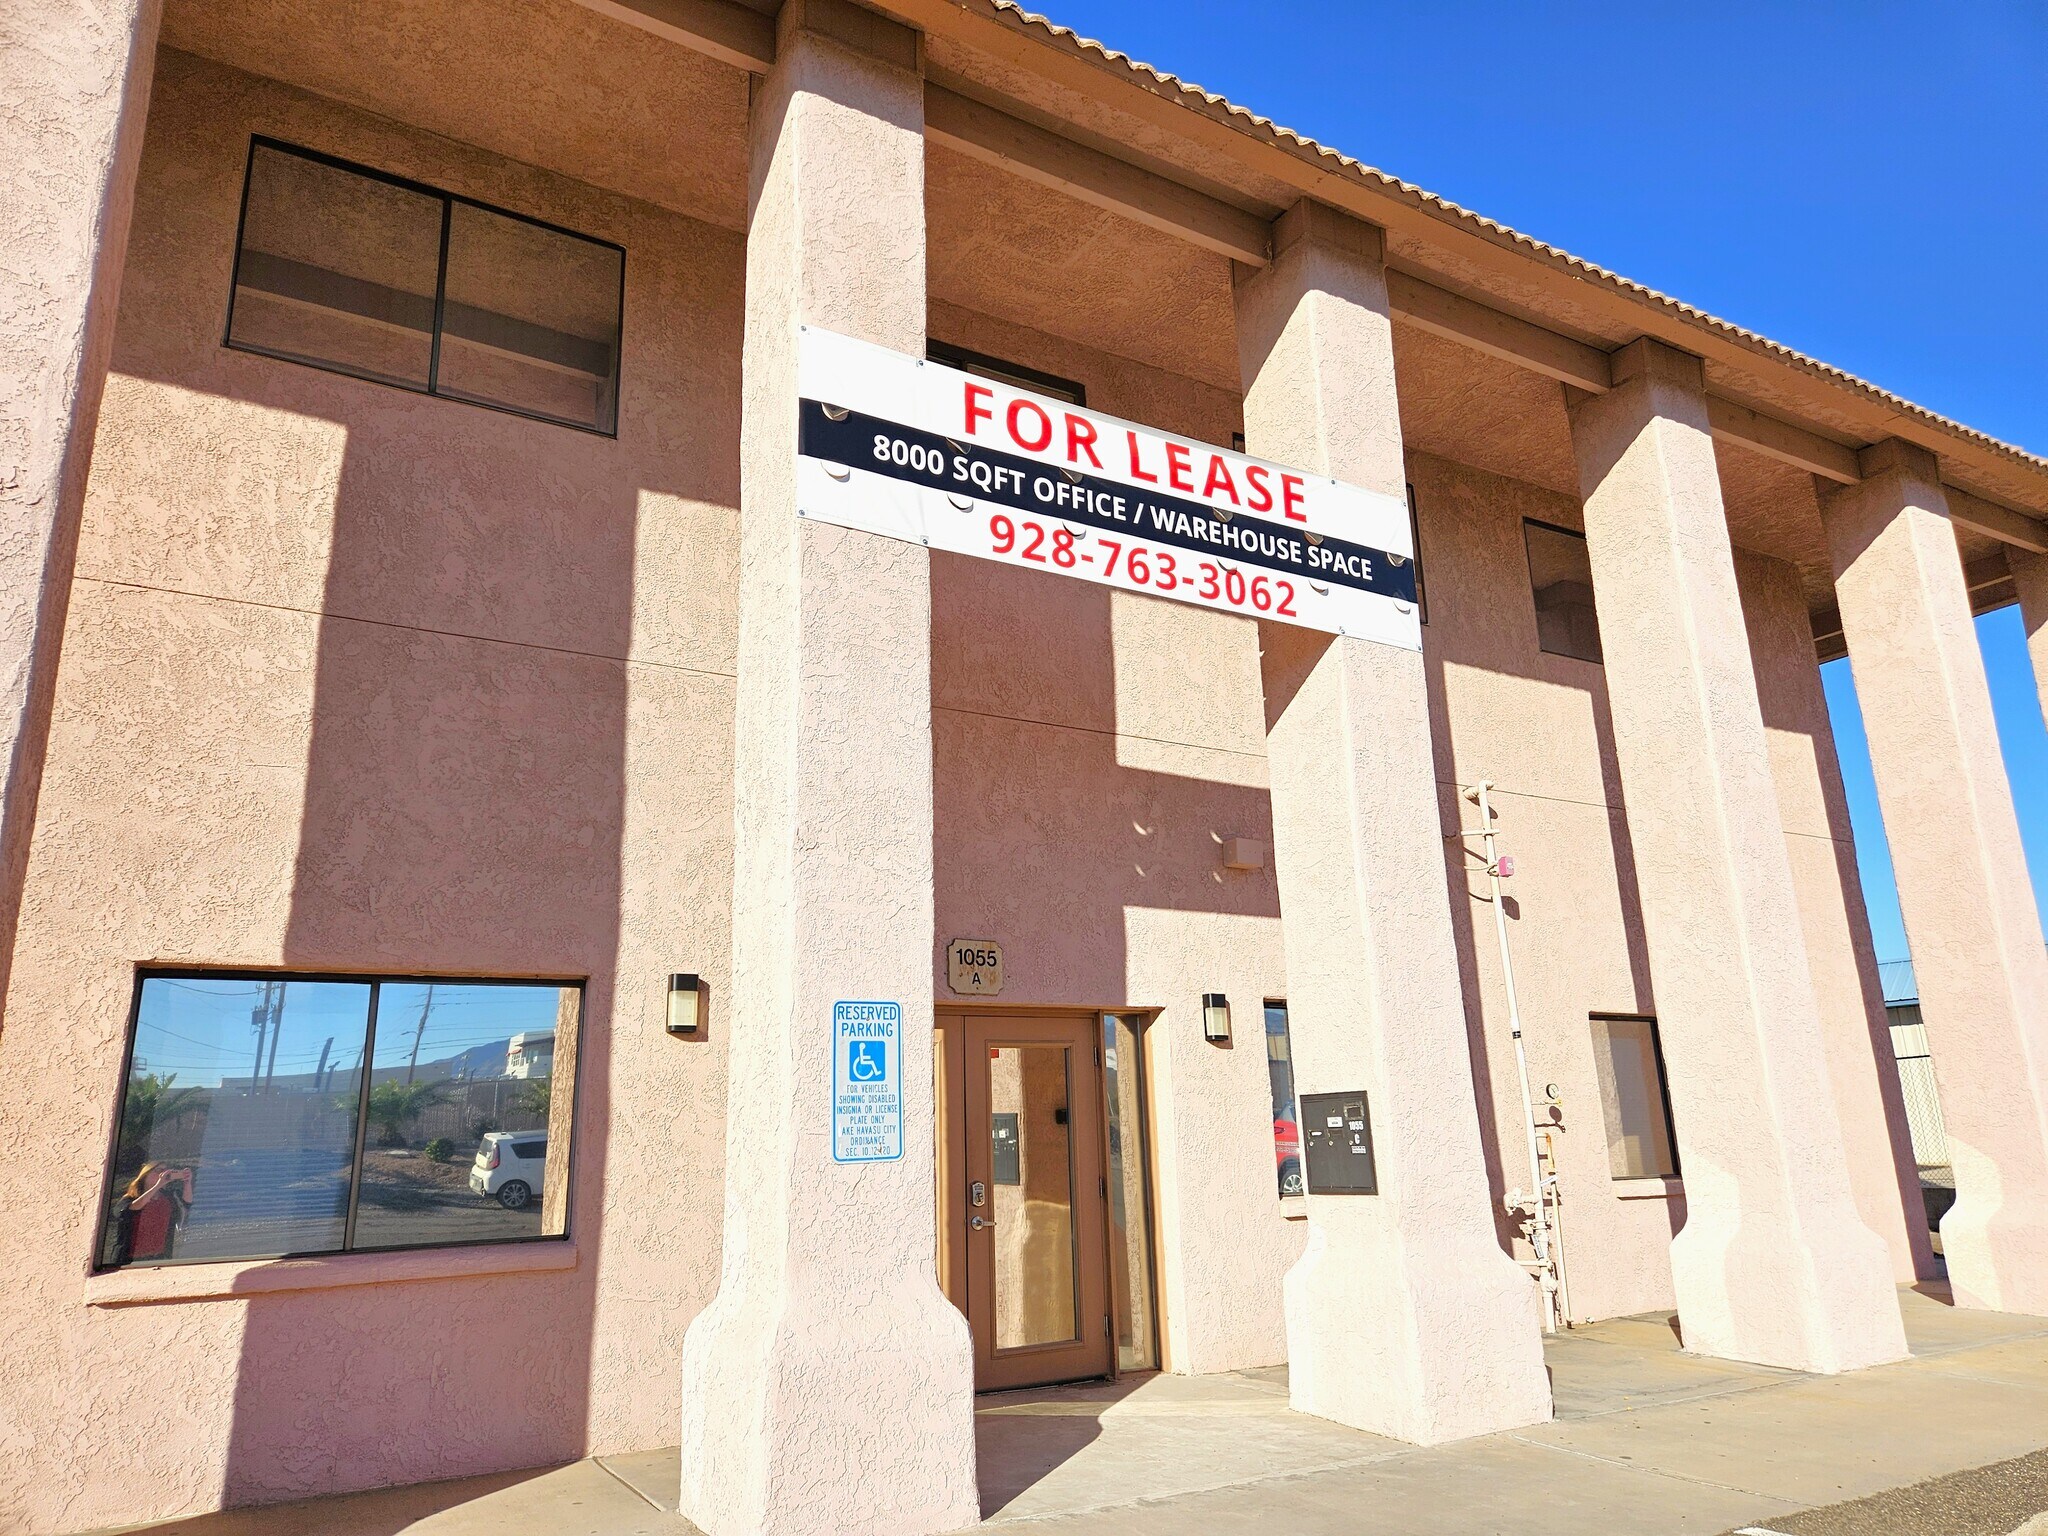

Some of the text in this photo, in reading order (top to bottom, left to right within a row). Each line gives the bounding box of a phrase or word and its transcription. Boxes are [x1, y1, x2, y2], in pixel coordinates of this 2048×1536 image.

[963, 382, 1308, 523] FOR LEASE
[873, 434, 1373, 581] 8000 SQFT OFFICE / WAREHOUSE SPACE
[989, 514, 1297, 617] 928-763-3062
[956, 948, 997, 967] 1055
[972, 972, 981, 985] A
[837, 1005, 897, 1021] RESERVED
[841, 1022, 893, 1038] PARKING
[847, 1084, 889, 1094] FOR VEHICLES
[839, 1094, 896, 1105] SHOWING DISABLED
[836, 1104, 898, 1115] INSIGNIA OR LICENSE
[850, 1115, 885, 1125] PLATE ONLY
[1348, 1120, 1364, 1131] 1055
[839, 1124, 896, 1136] AKE HAVASU CITY
[850, 1135, 886, 1146] ORDINANCE
[845, 1147, 860, 1157] SEC.
